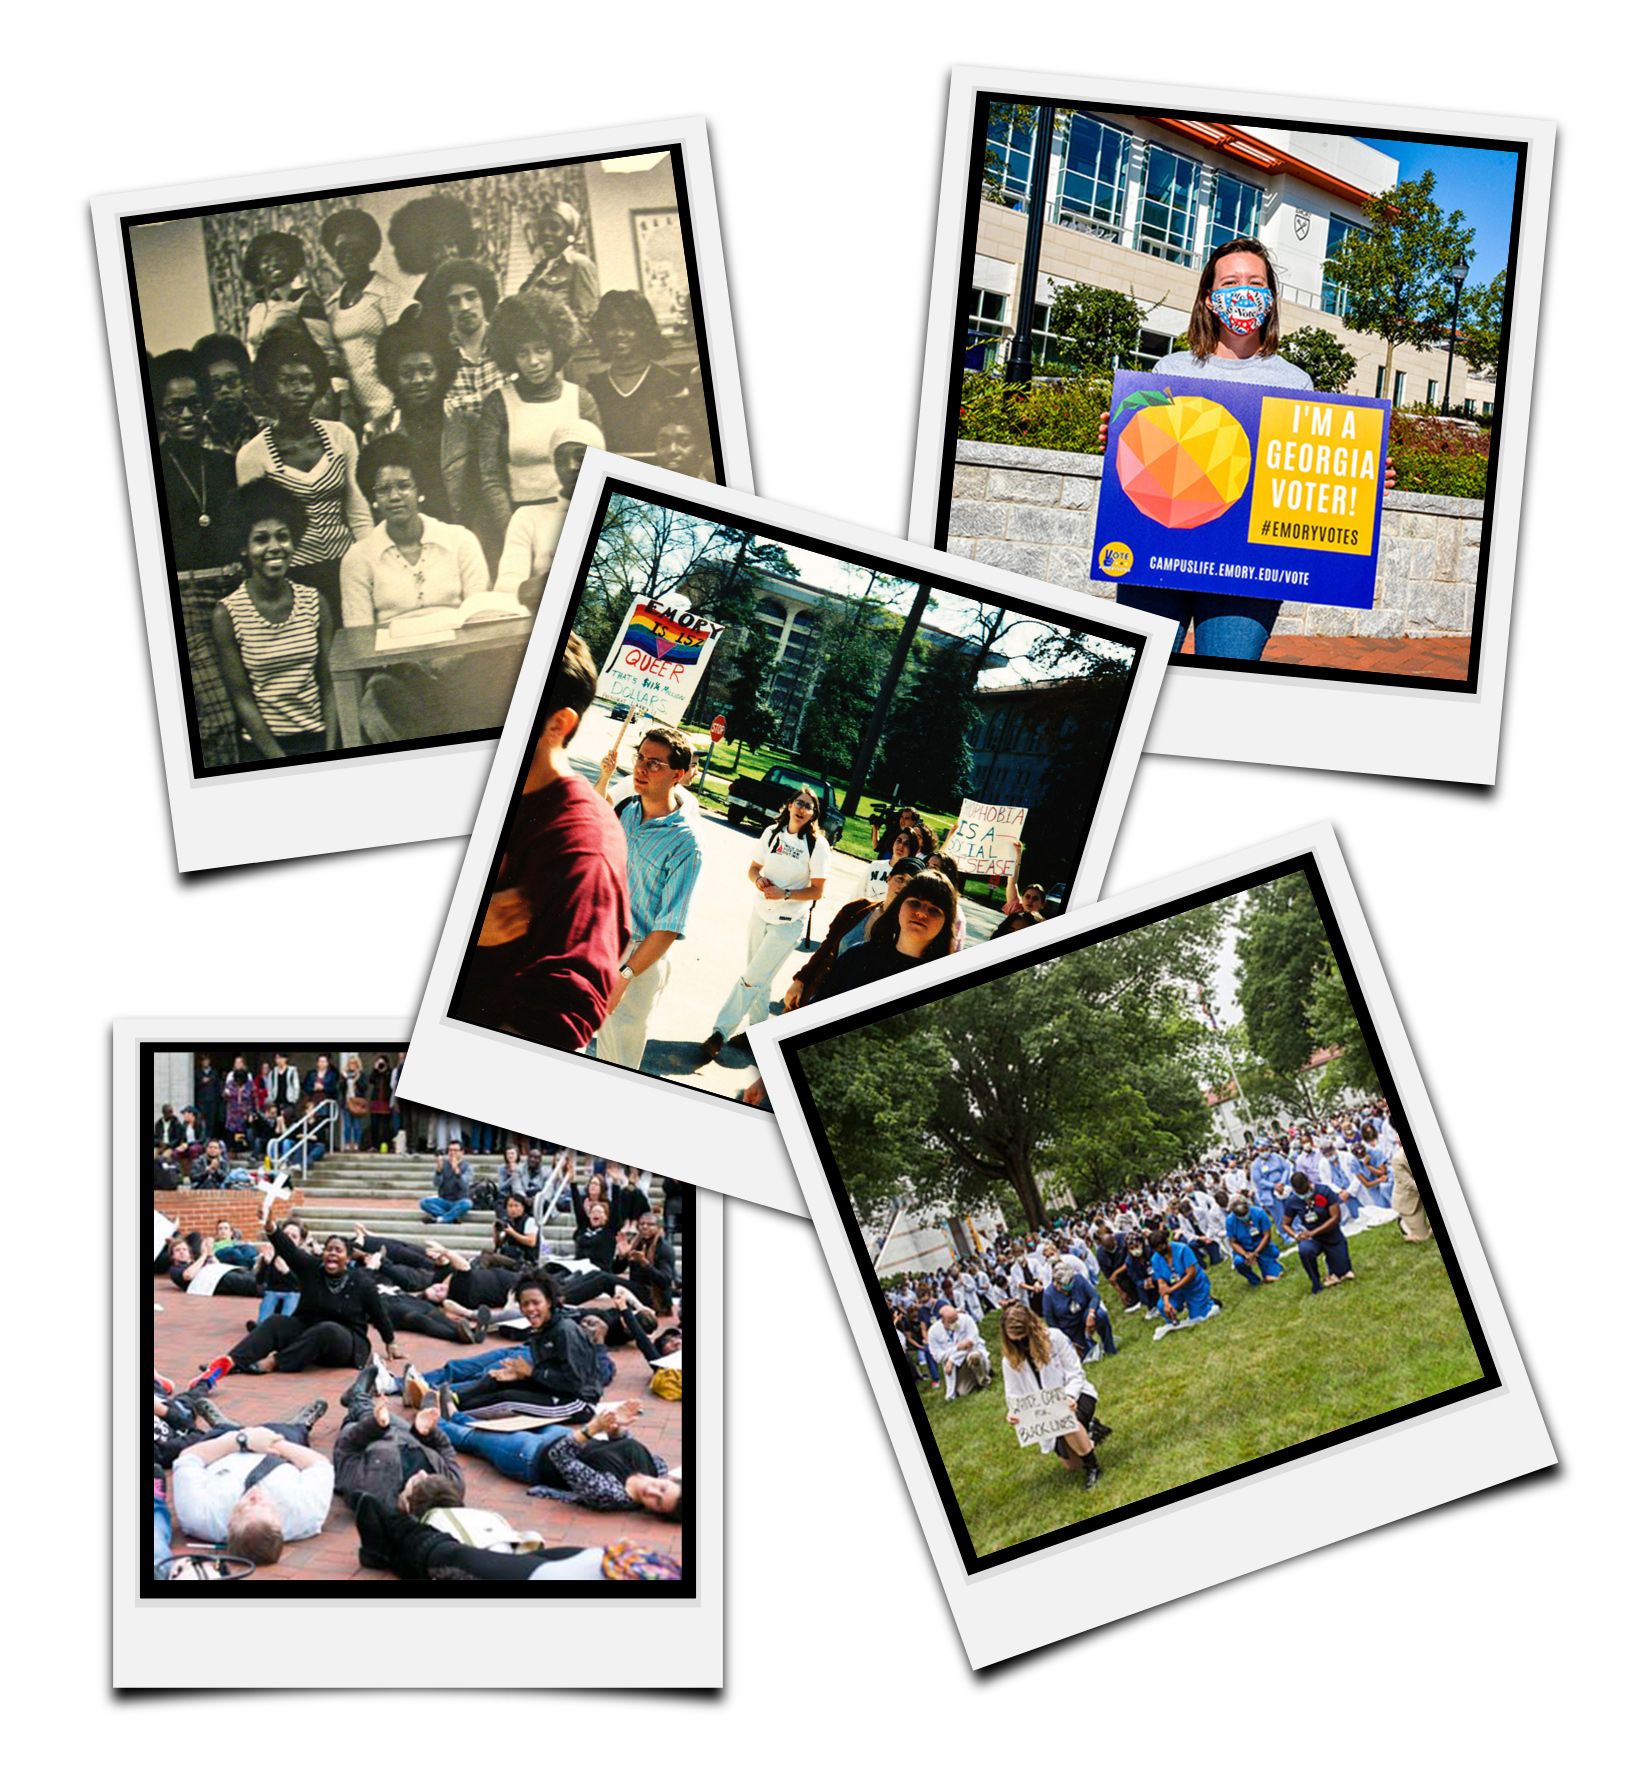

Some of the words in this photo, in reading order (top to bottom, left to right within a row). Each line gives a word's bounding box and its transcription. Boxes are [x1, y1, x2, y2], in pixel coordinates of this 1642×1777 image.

[1292, 404, 1332, 437] I'M
[1340, 410, 1356, 440] A
[1266, 440, 1375, 480] GEORGIA
[1271, 478, 1357, 516] VOTER!
[1261, 520, 1359, 546] #EMORYVOTES
[1149, 555, 1310, 586] CAMPUSLIFE.EMORY.EDU/VOTE
[644, 600, 725, 640] EMORY
[650, 621, 667, 638] IS
[625, 649, 685, 685] QUEER
[711, 722, 725, 734] STOP
[956, 820, 979, 839] IS
[980, 826, 995, 842] A
